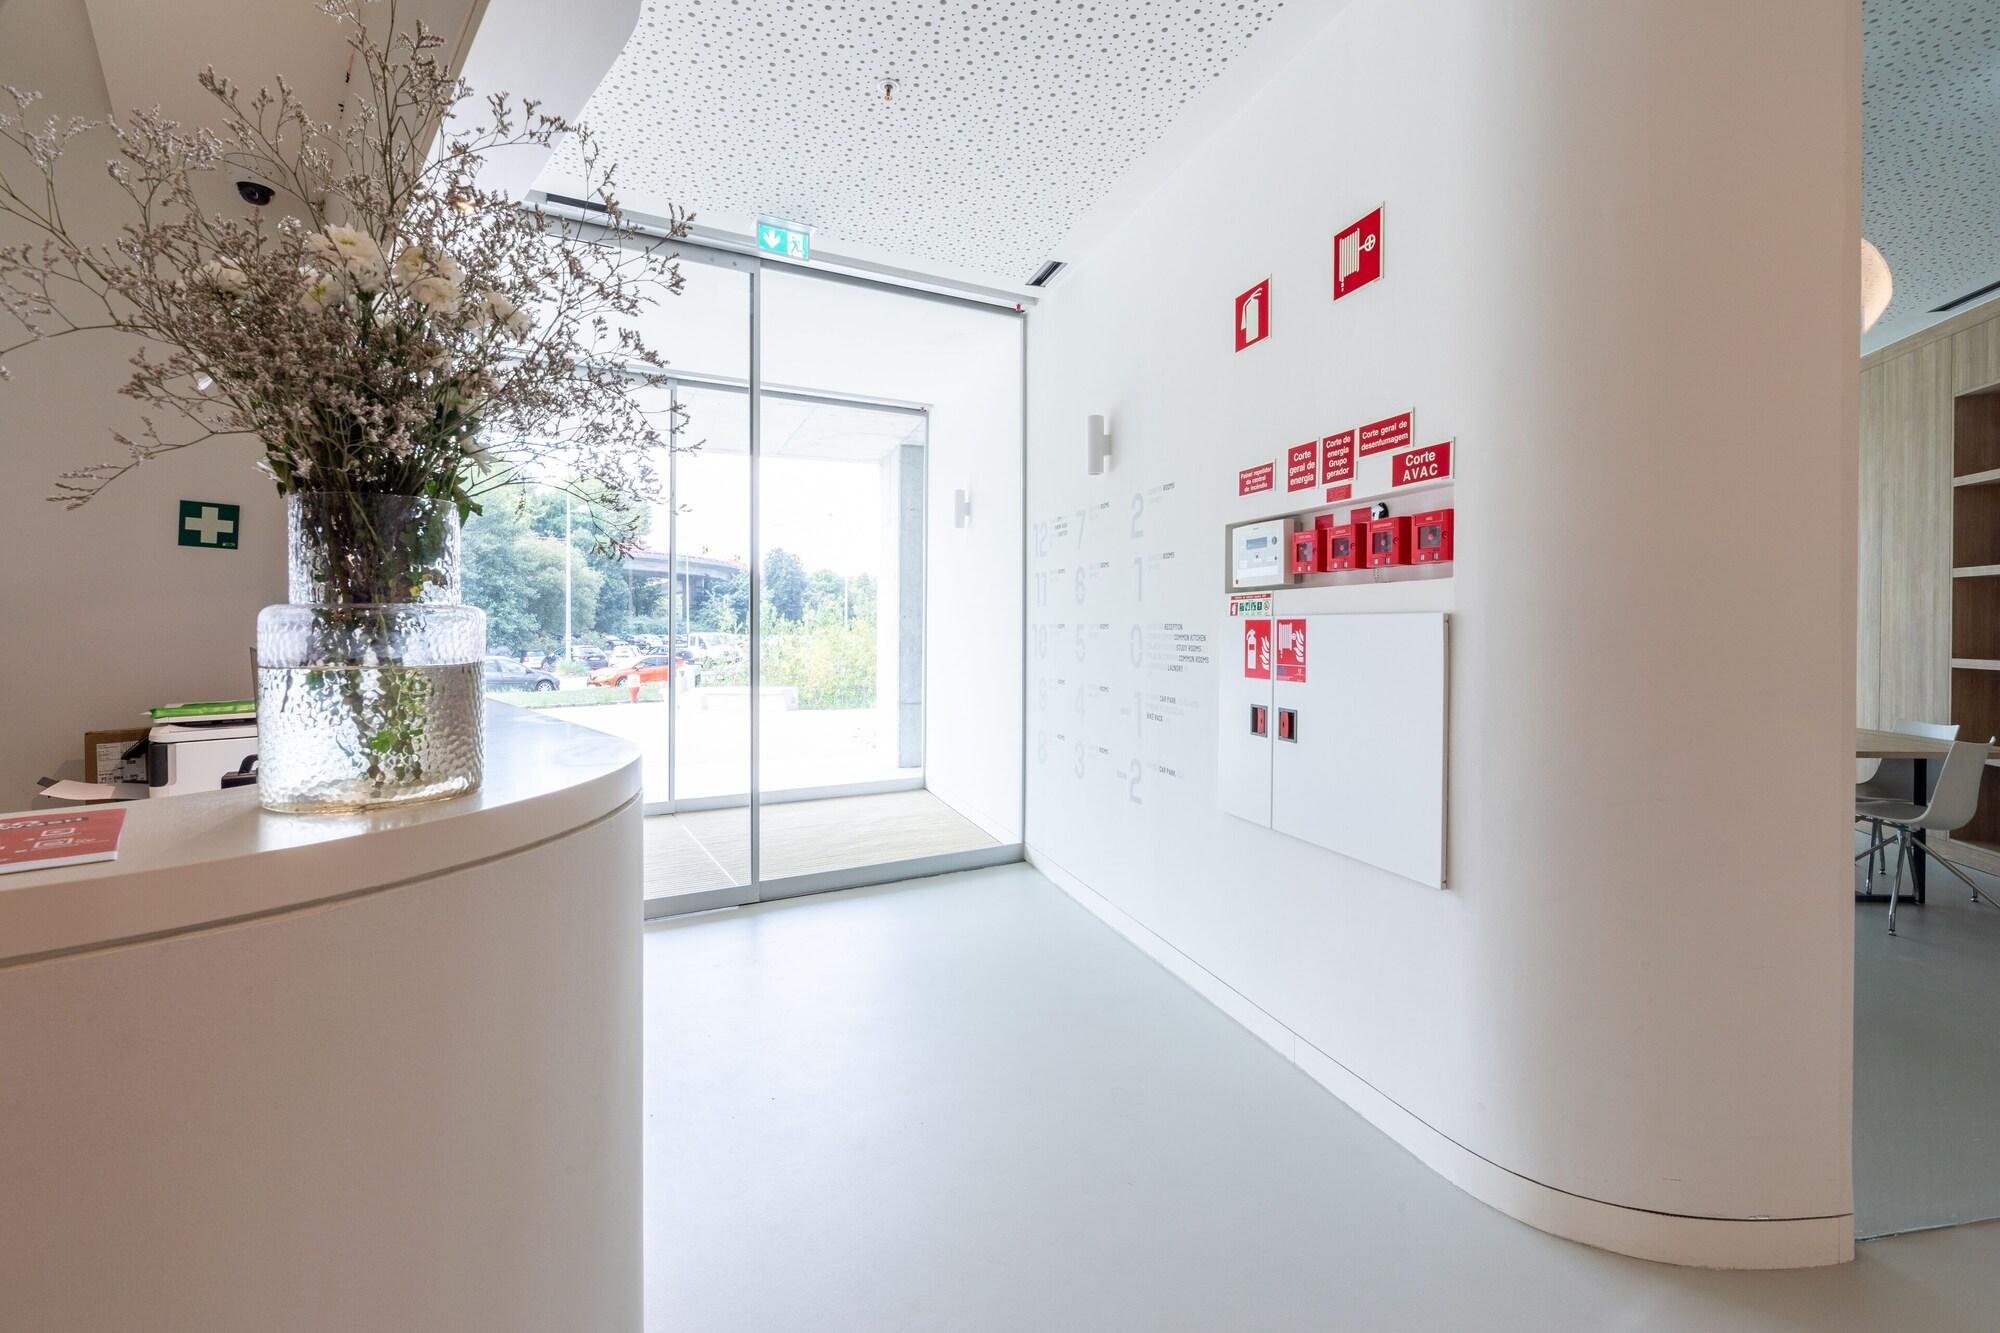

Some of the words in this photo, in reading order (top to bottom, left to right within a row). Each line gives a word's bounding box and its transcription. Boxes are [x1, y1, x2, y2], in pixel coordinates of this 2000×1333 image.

[1362, 428, 1378, 439] Corte
[1380, 423, 1397, 436] geral
[1398, 420, 1408, 429] de
[1326, 438, 1342, 448] Corte
[1342, 436, 1351, 444] de
[1361, 432, 1408, 451] desenfumagem
[1294, 450, 1312, 462] Corte
[1327, 446, 1349, 458] energia
[1406, 451, 1436, 466] Corte
[1290, 462, 1305, 476] geral
[1306, 460, 1315, 470] de
[1328, 458, 1347, 468] Grupo
[1290, 472, 1314, 486] energia
[1326, 466, 1350, 480] gerador
[1403, 464, 1438, 482] AVAC
[1132, 493, 1144, 539] 2
[1076, 509, 1086, 550] 7
[1032, 522, 1048, 558] 12
[1034, 571, 1047, 608] 11
